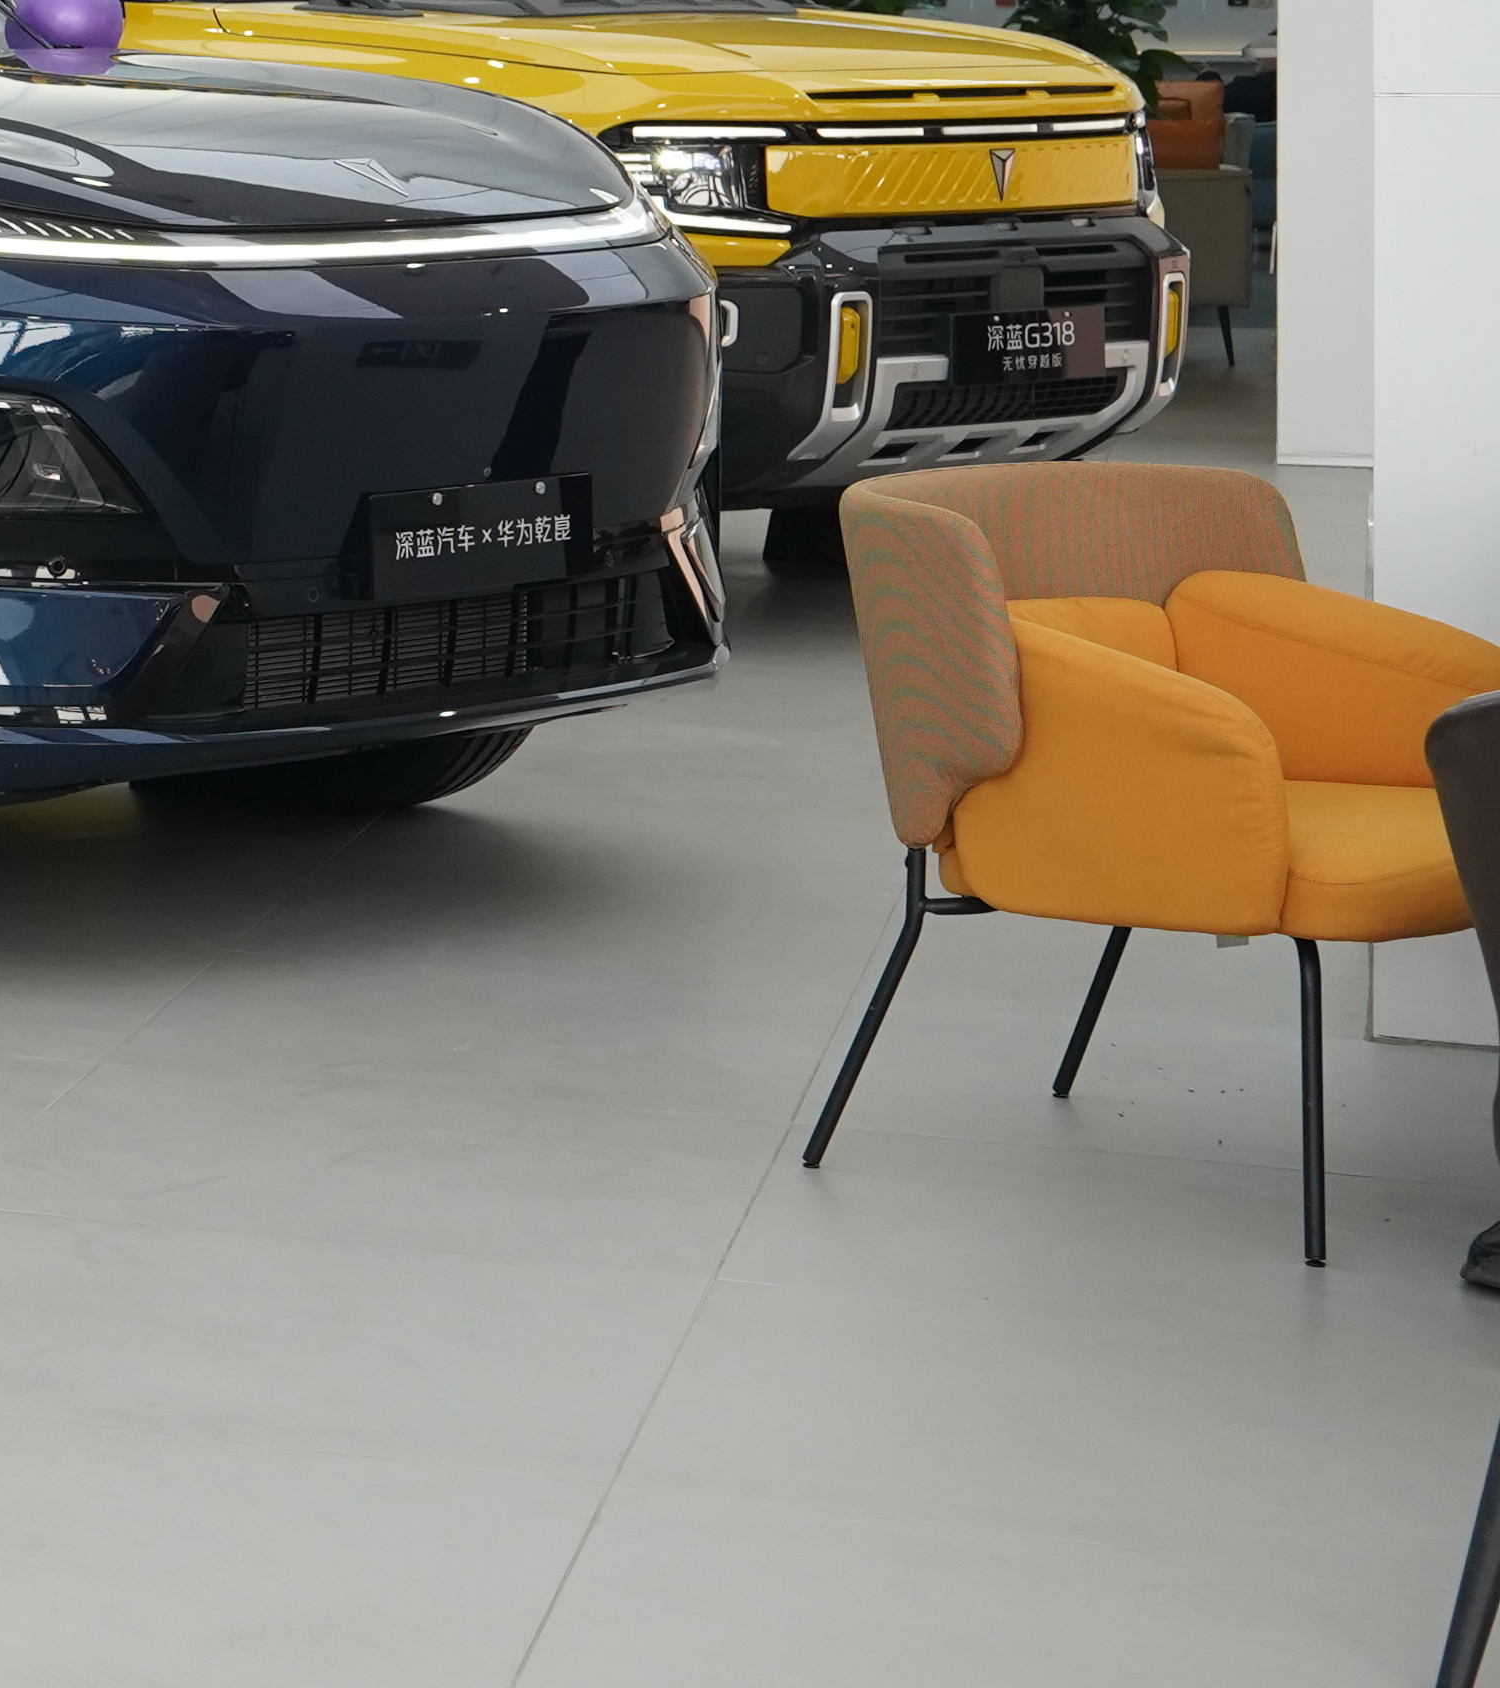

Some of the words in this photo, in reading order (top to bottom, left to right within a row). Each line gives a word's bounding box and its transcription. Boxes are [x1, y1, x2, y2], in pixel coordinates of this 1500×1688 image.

[986, 320, 1076, 352] 深蓝G318
[1001, 352, 1064, 372] 无忧穿越版
[394, 525, 476, 561] 深蓝汽车
[496, 514, 572, 548] 华为乾崑
